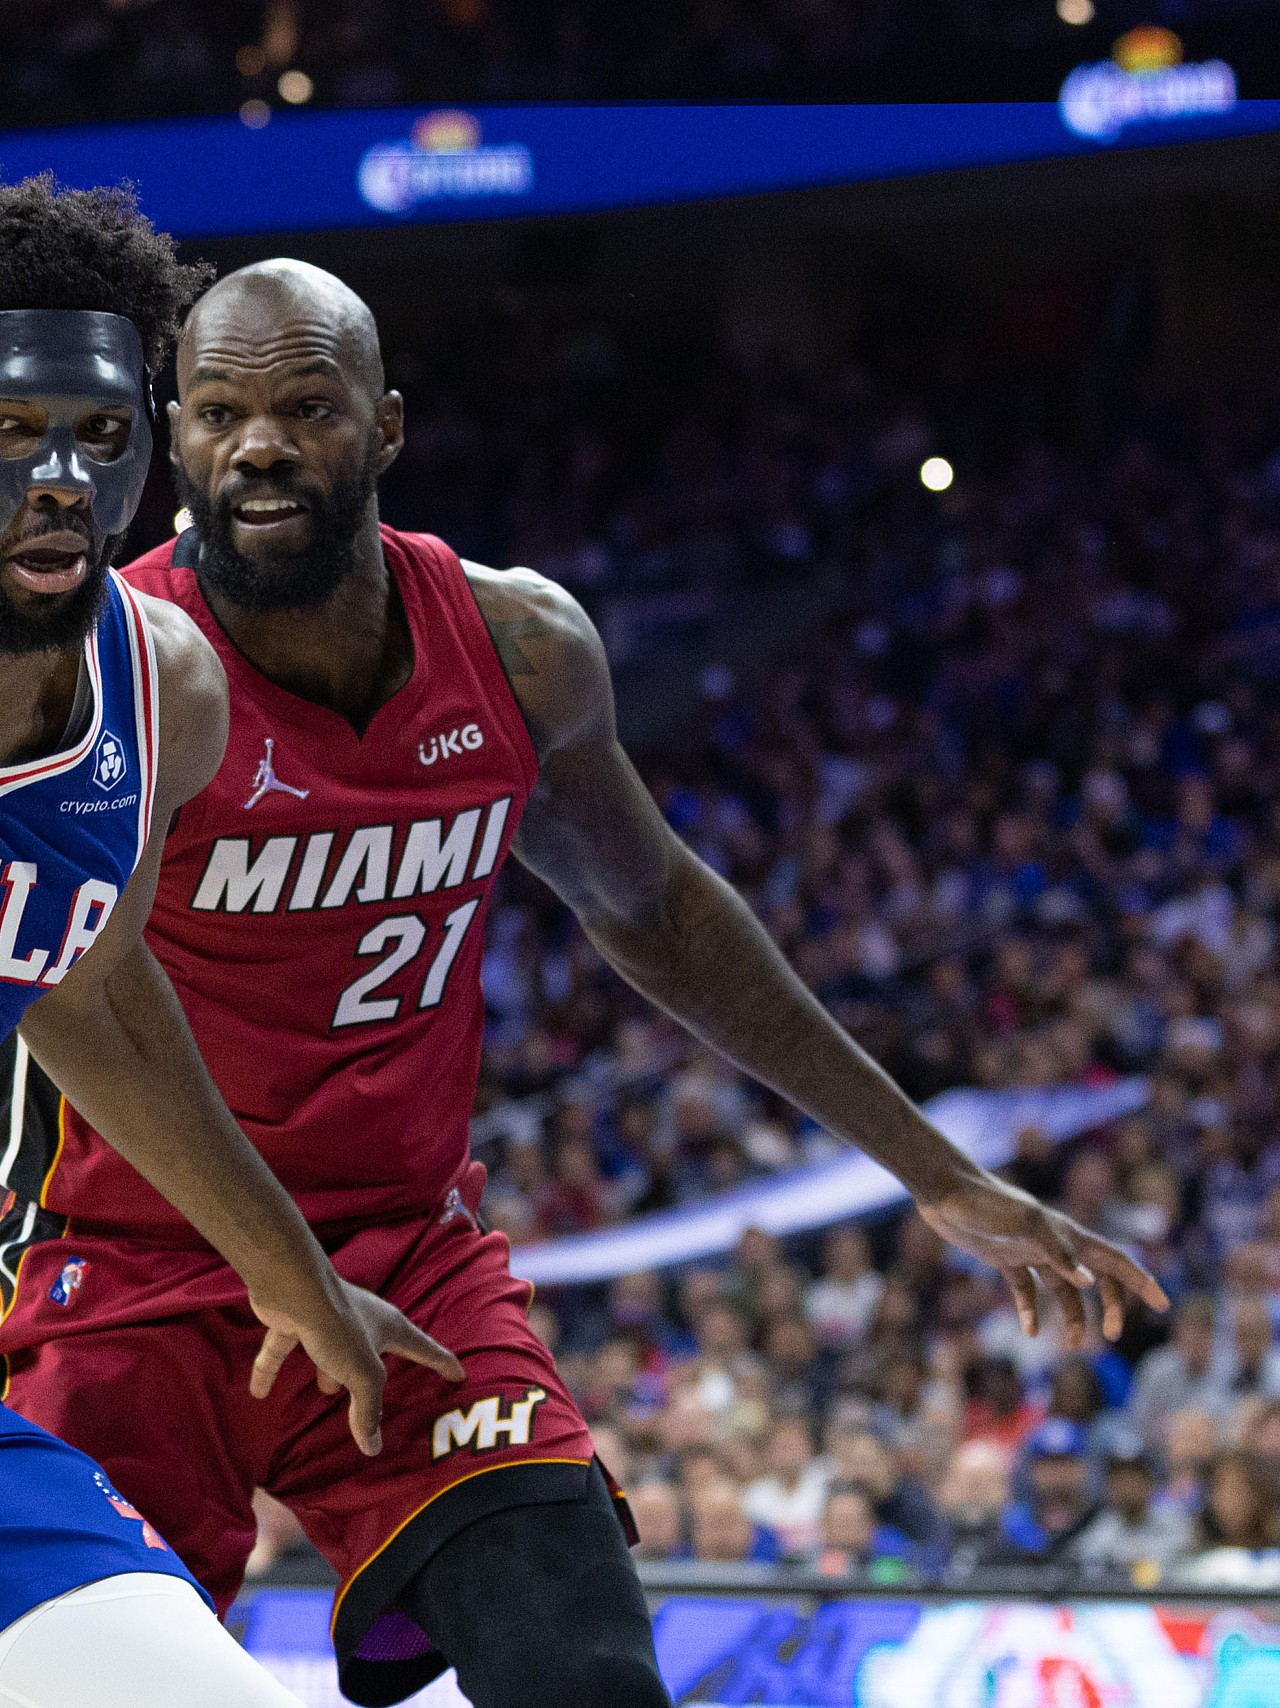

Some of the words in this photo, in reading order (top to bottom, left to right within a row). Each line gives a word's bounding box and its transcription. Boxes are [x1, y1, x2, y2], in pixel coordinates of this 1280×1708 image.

[59, 793, 137, 815] crypto.com
[190, 796, 513, 914] MIAMI
[328, 896, 480, 1031] 21
